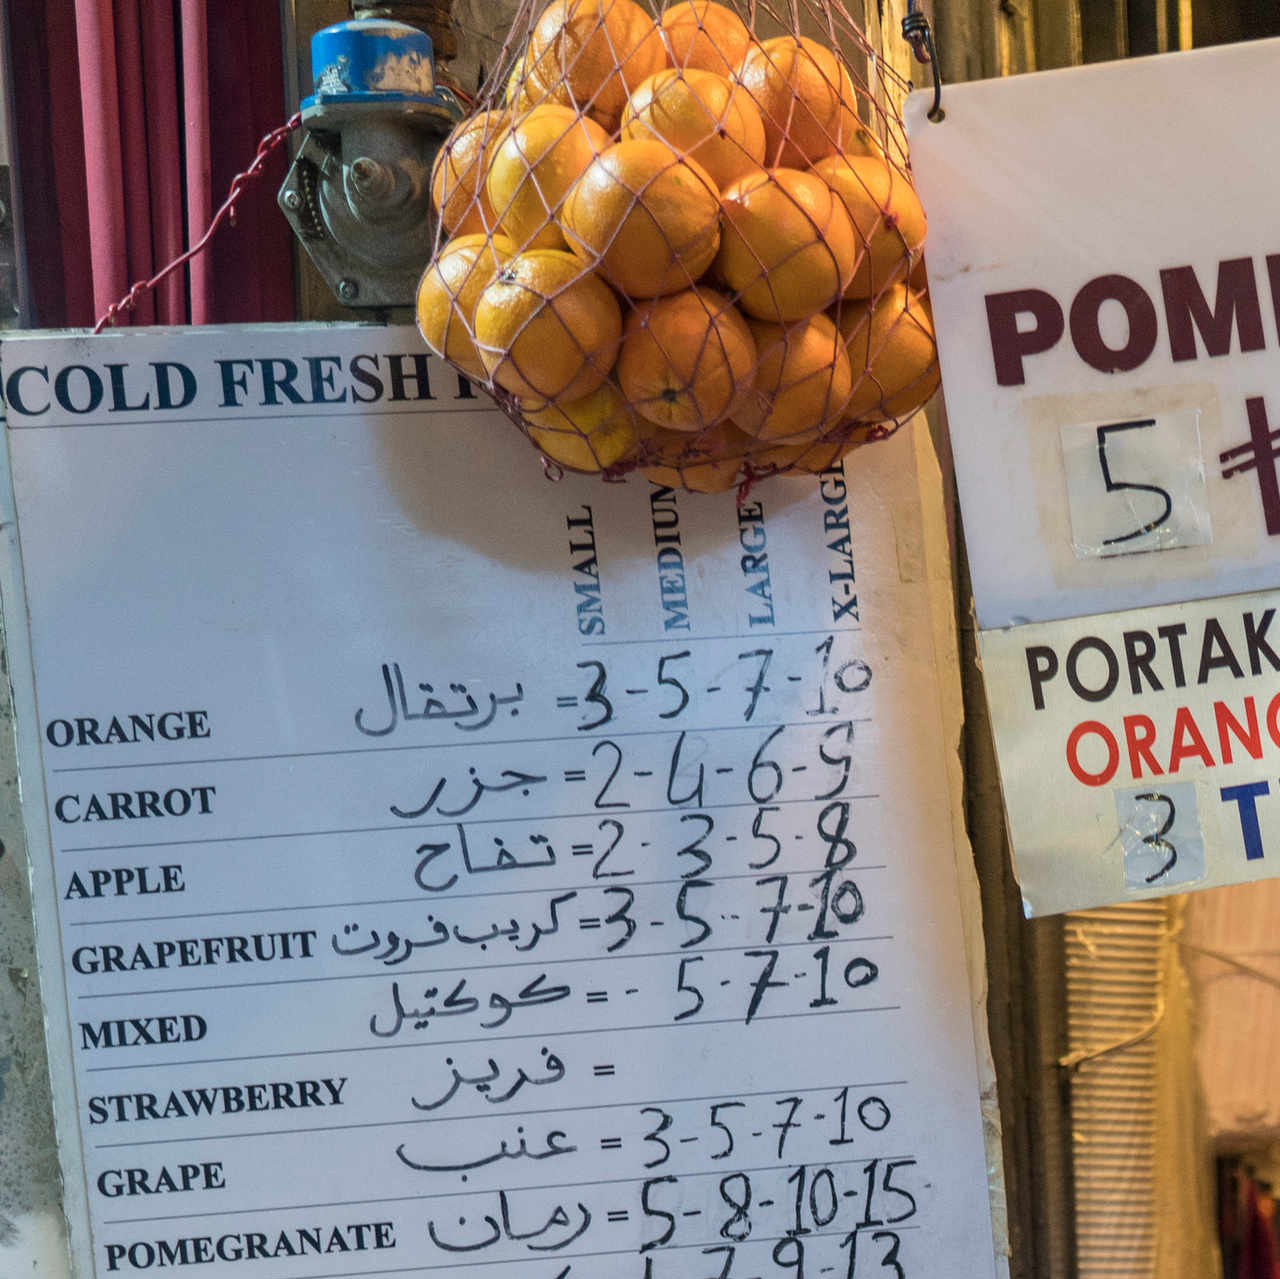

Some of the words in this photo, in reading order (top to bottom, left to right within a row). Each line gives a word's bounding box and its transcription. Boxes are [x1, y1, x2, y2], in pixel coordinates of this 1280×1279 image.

[5, 361, 198, 416] COLD
[214, 352, 437, 407] FRESH
[1096, 417, 1174, 546] 5
[567, 504, 605, 636] SMALL
[650, 480, 691, 632] MEDIUM
[739, 502, 775, 628] LARGE
[46, 711, 211, 748] ORANGE
[55, 786, 217, 824] CARROT
[1134, 793, 1177, 884] 3
[64, 865, 186, 900] APPLE
[71, 930, 317, 975] GRAPEFRUIT
[80, 1013, 208, 1050] MIXED
[88, 1077, 349, 1125] STRAWBERRY
[96, 1161, 226, 1198] GRAPE
[105, 1222, 396, 1271] POMEGRANATE
